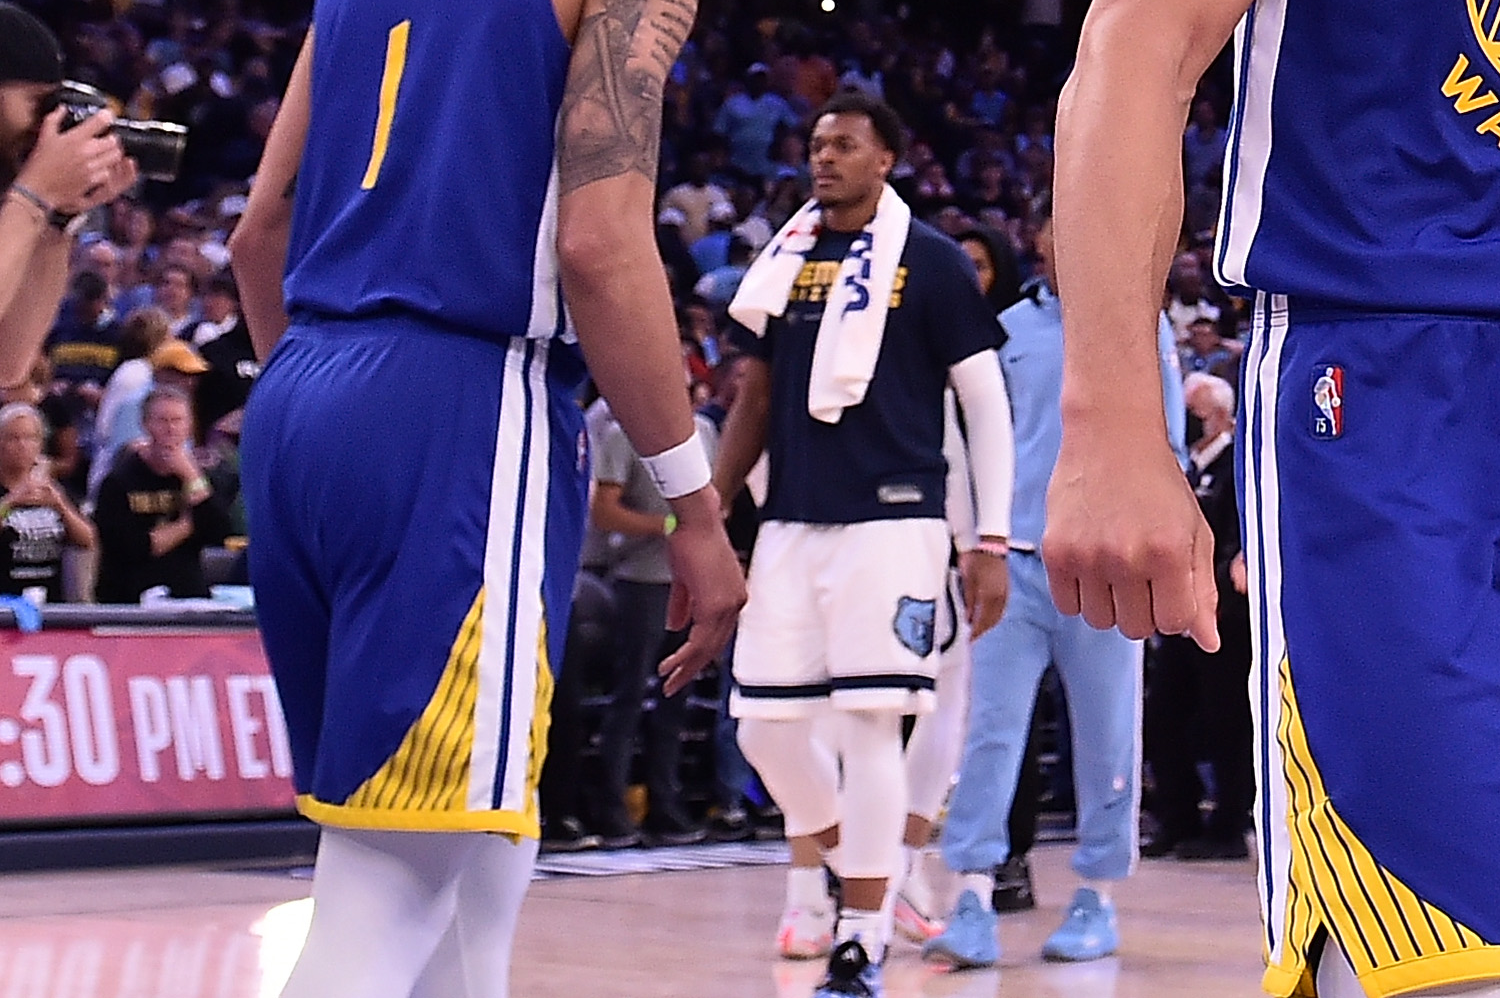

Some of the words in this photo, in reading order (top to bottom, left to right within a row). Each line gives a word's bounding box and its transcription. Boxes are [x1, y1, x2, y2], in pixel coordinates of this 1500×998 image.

[360, 19, 411, 191] 1
[1314, 417, 1327, 434] 75
[128, 674, 226, 783] PM
